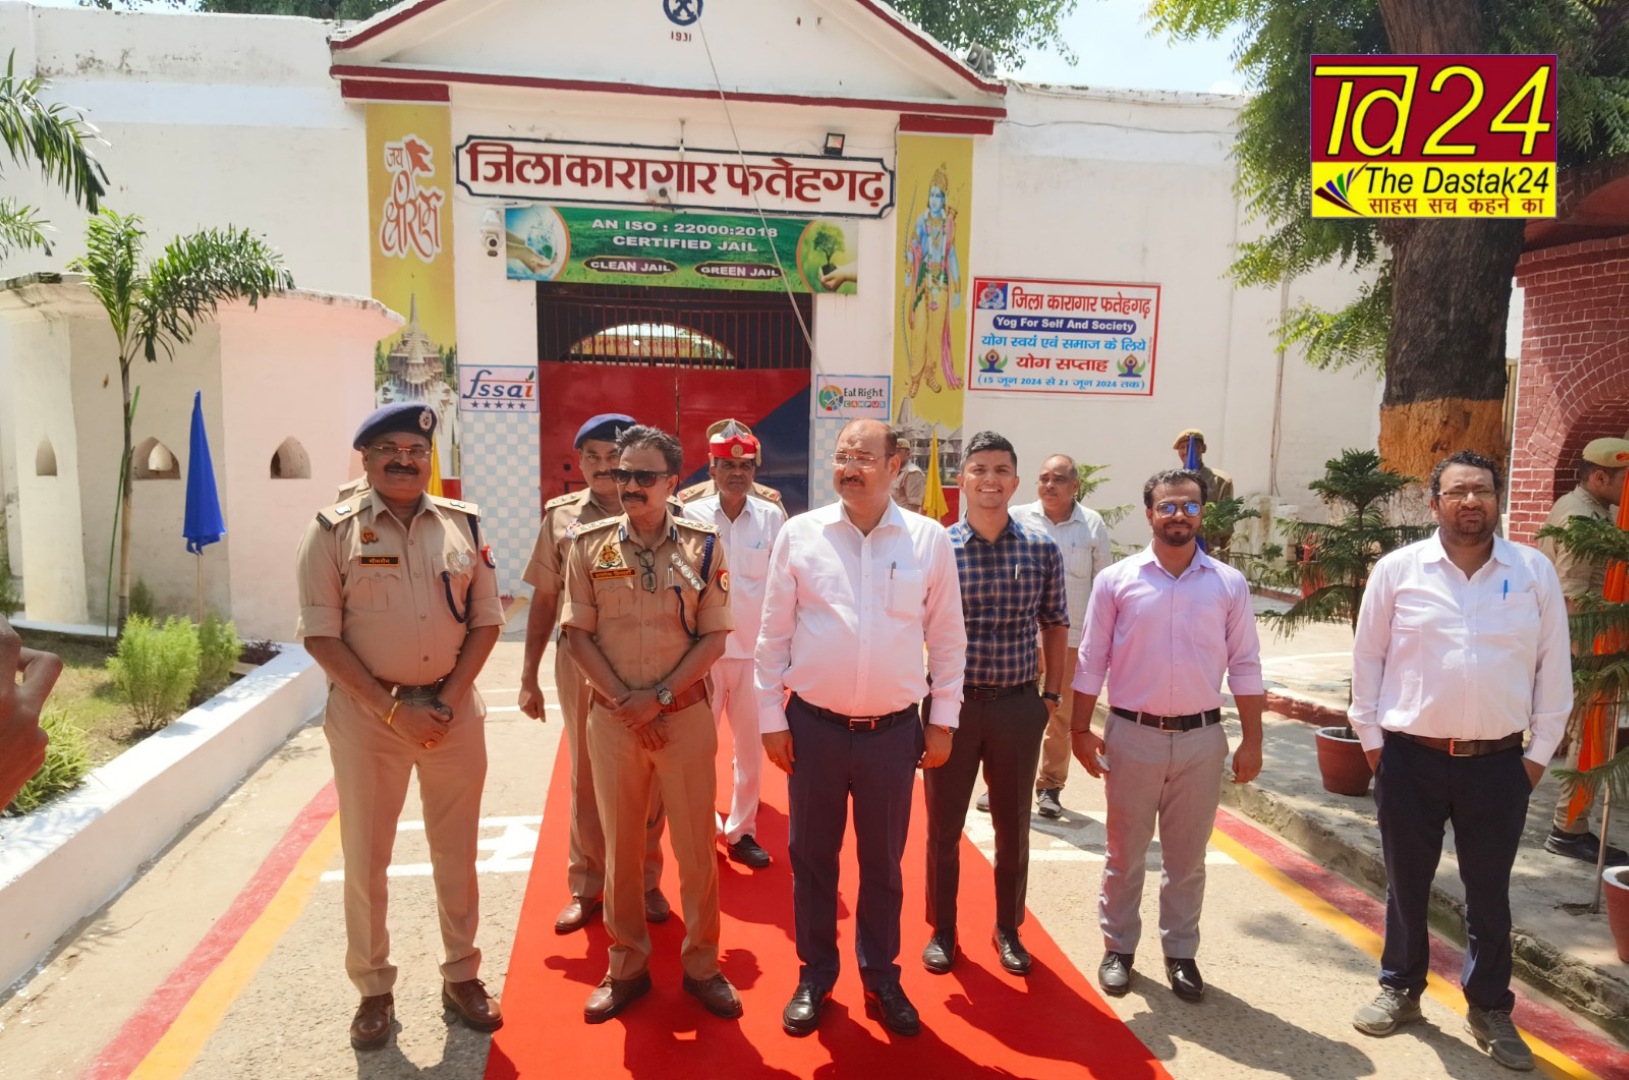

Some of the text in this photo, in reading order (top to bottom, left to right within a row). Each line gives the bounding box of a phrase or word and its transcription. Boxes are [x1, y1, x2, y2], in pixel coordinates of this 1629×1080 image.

[671, 30, 692, 42] 1931
[386, 146, 404, 168] जय
[722, 157, 885, 208] फतेहगढ़
[592, 218, 619, 230] AN
[625, 220, 657, 232] ISO
[674, 223, 778, 238] 22000:2018
[613, 235, 758, 253] CERTIFIED JAIL
[590, 260, 671, 273] CLEAN JAIL
[700, 265, 779, 278] GREEN JAIL
[1011, 286, 1152, 319] जिला कारागार फतेहगढ़
[996, 316, 1134, 333] Yog For Self And Society
[981, 333, 1007, 347] योग
[1010, 334, 1037, 348] स्वयं
[1041, 335, 1059, 349] एवं
[1062, 338, 1100, 350] समाज
[1104, 337, 1117, 351] के
[1121, 337, 1147, 351] लिये
[1016, 353, 1110, 373] योग सप्ताह
[462, 369, 534, 399] fssai
[977, 374, 1146, 390] (15 जून 2024 से 21 जून 2024 तक)
[843, 387, 884, 399] Eat Right
